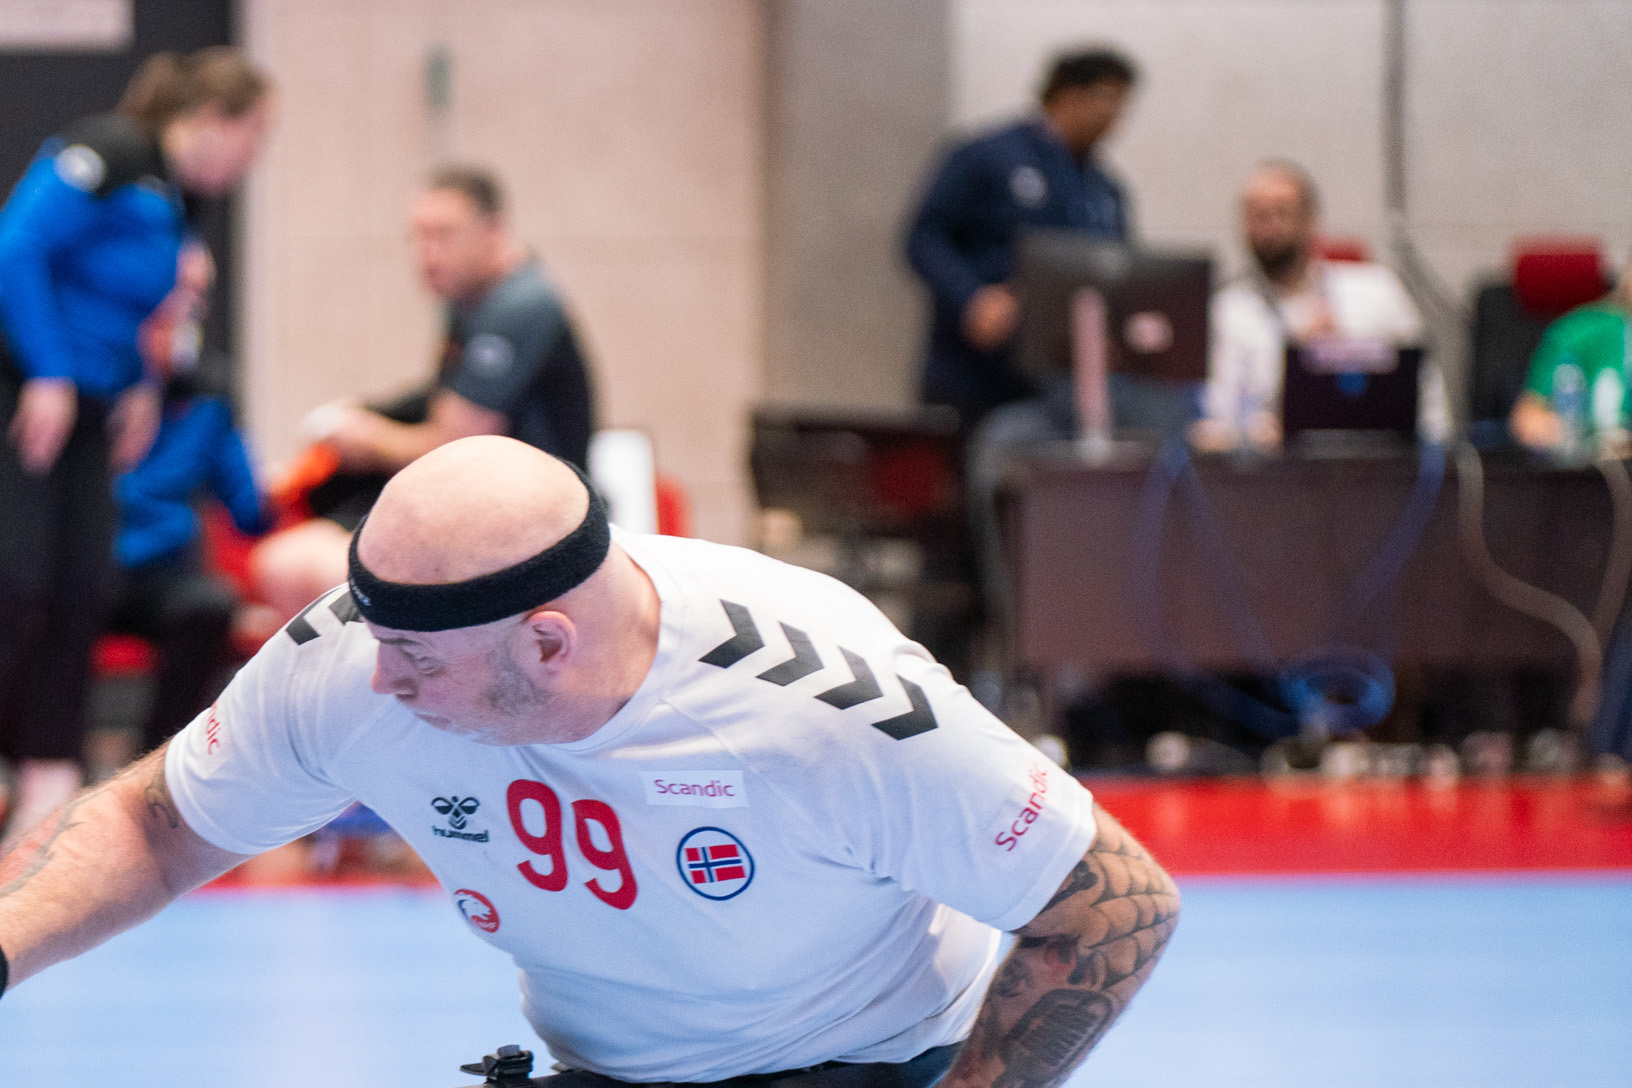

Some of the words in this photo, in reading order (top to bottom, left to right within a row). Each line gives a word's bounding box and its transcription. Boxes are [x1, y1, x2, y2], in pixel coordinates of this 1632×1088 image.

[654, 779, 736, 798] Scandic
[995, 762, 1048, 852] Scandic
[431, 825, 490, 843] hummel
[506, 779, 638, 911] 99
